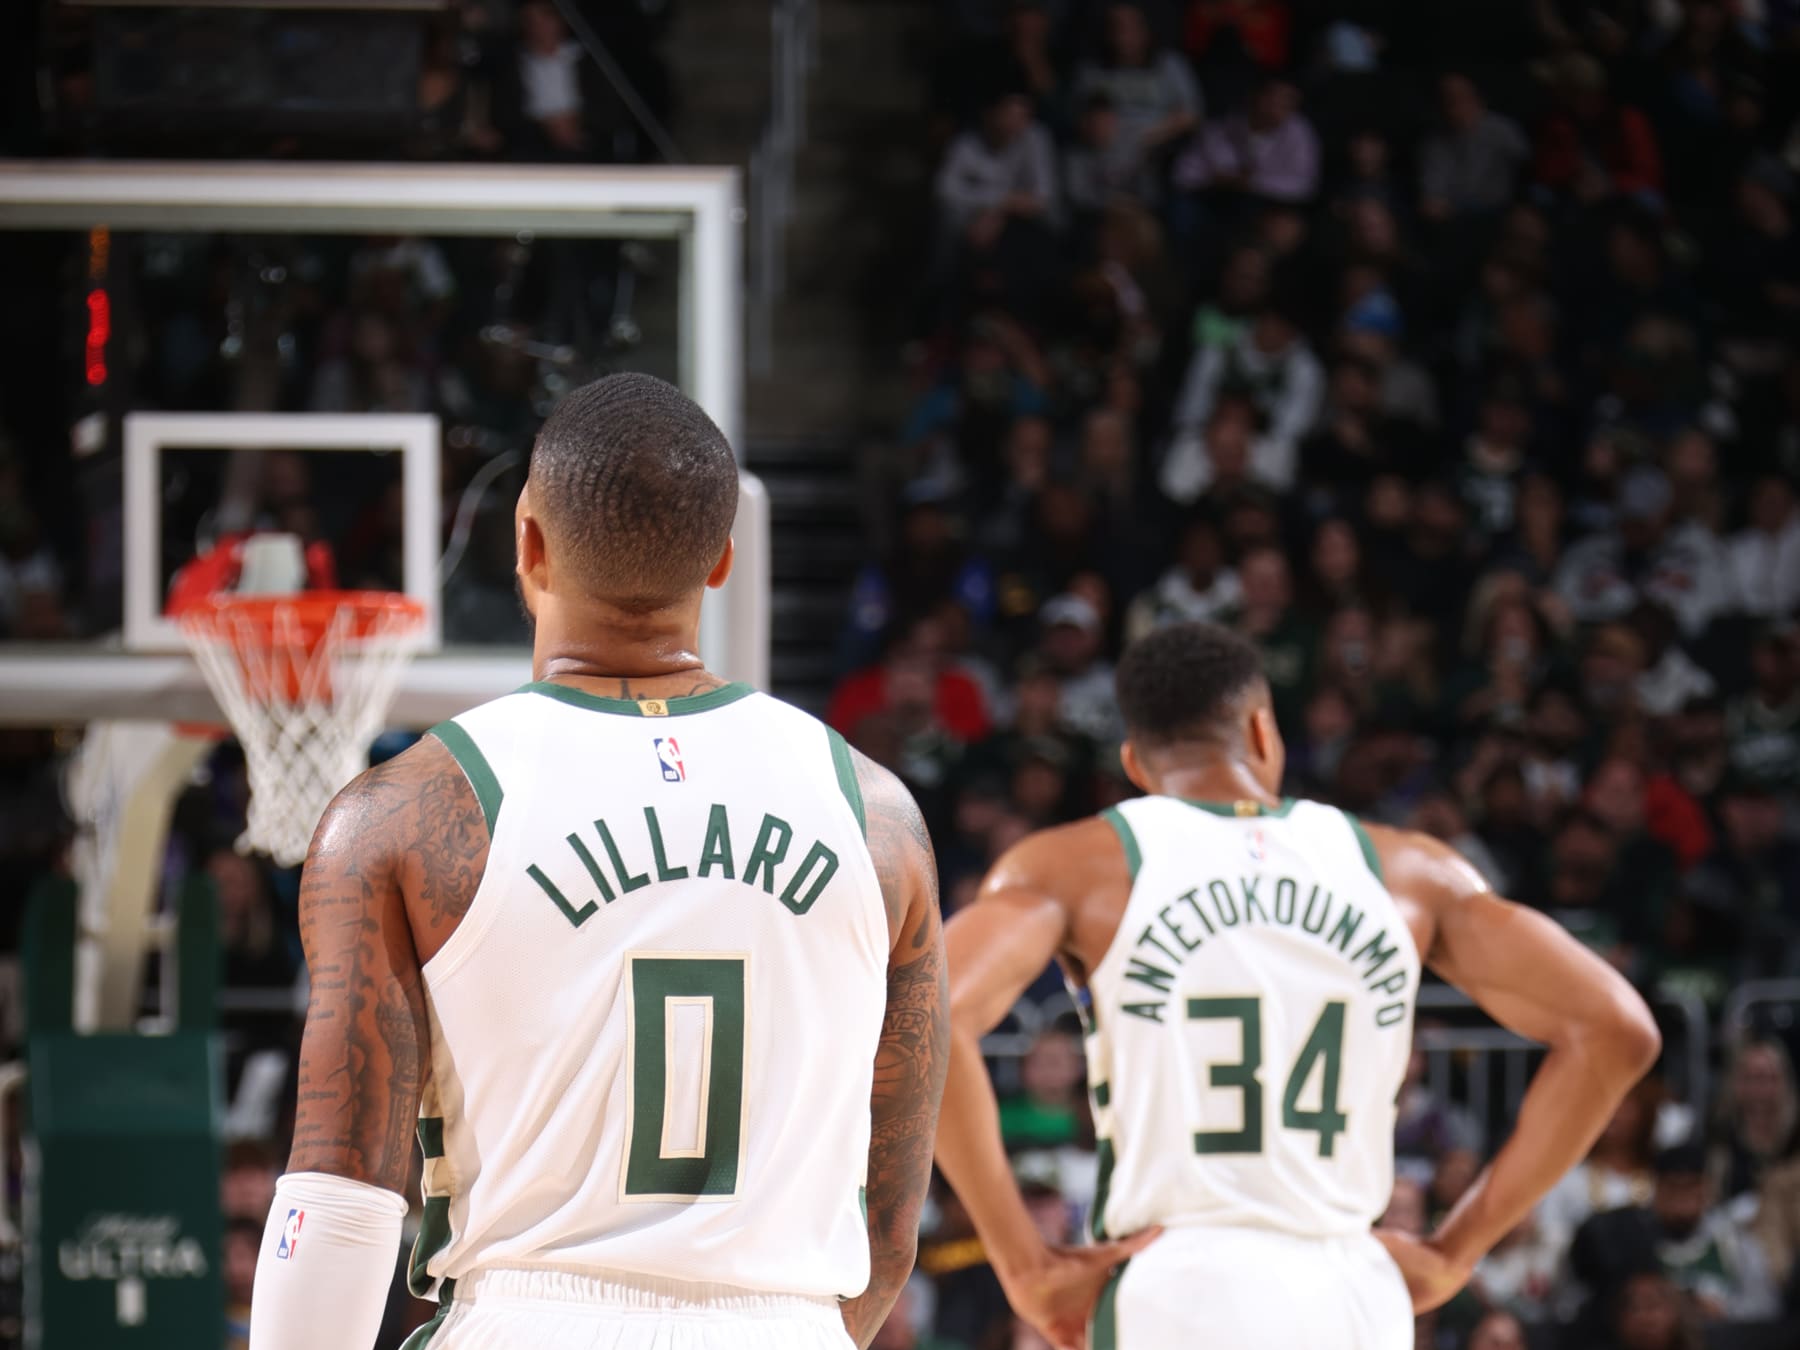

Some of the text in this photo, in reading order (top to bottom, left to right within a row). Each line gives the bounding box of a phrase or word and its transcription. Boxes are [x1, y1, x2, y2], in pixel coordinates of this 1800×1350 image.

[525, 803, 840, 929] LILLARD
[1121, 873, 1407, 1030] ANTETOKOUNMPO
[619, 952, 751, 1203] 0
[1184, 996, 1349, 1158] 34
